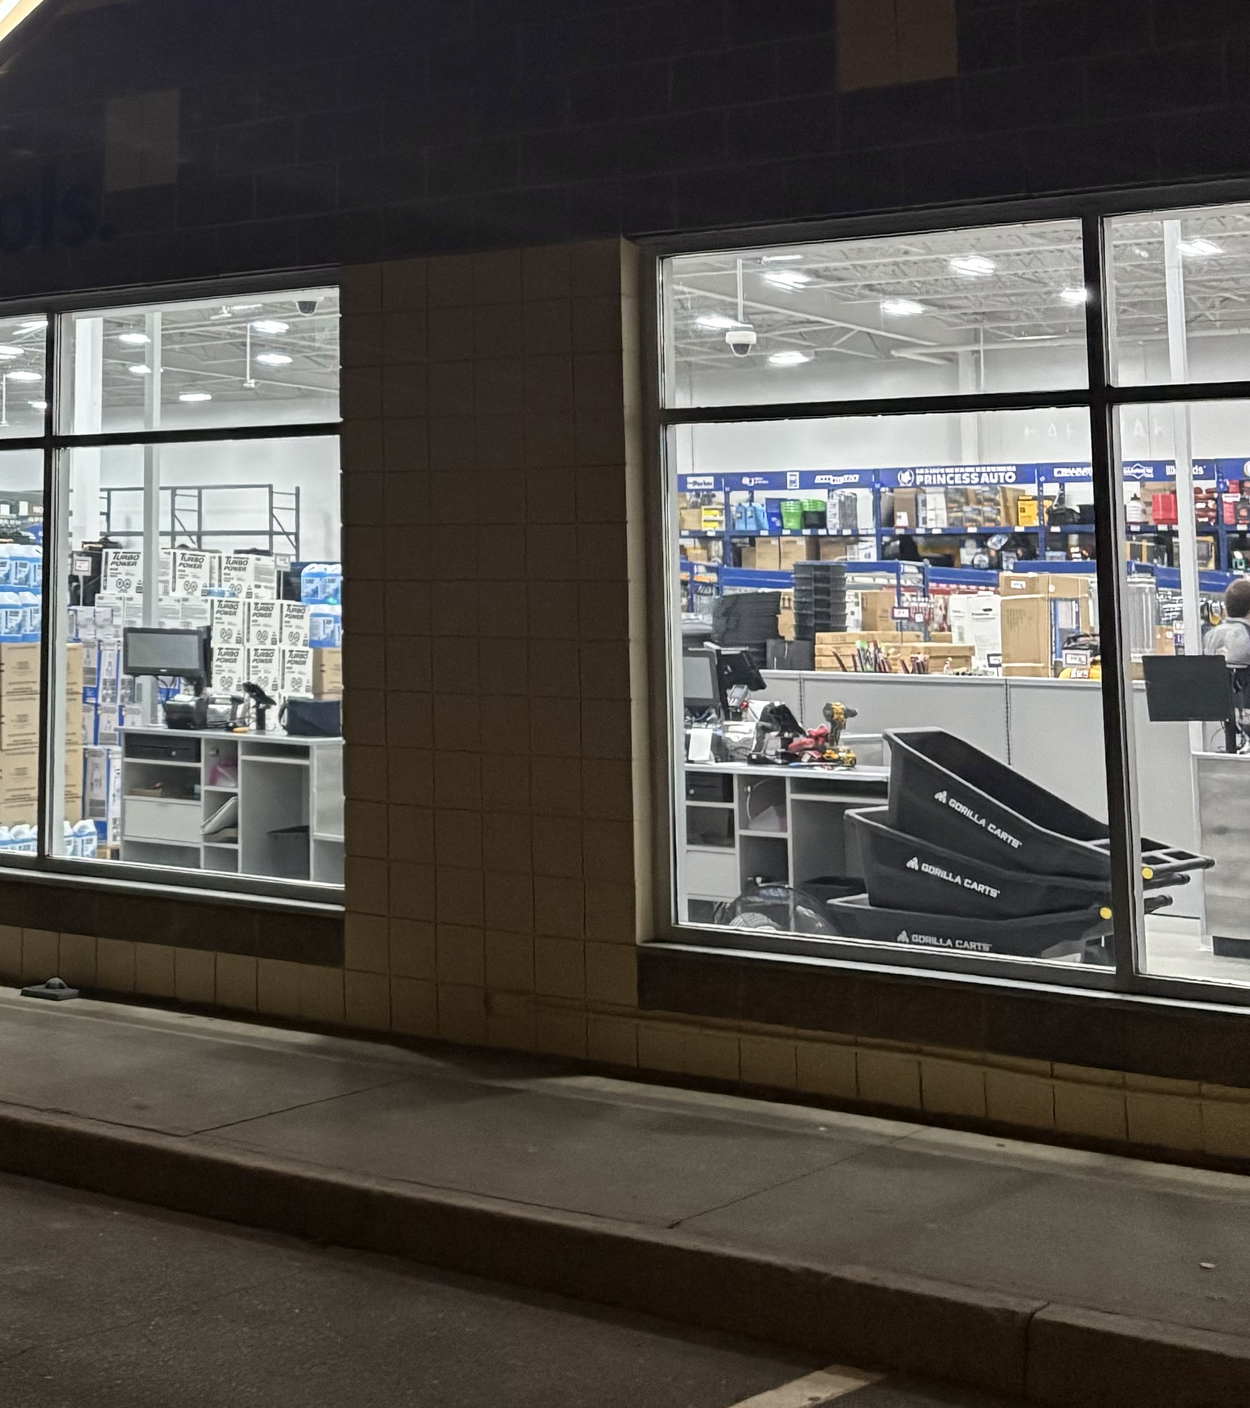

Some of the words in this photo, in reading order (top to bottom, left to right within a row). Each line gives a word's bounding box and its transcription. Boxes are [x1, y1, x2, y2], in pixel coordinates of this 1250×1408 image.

[915, 472, 980, 485] PRINCESS
[980, 471, 1017, 484] AUTO
[112, 551, 142, 561] TURBO
[180, 552, 206, 563] TURBO
[224, 555, 249, 566] TURBO
[948, 798, 986, 828] GORILLA
[987, 823, 1021, 849] CARTS
[920, 862, 962, 885] GORILLA
[963, 878, 999, 898] CARTS
[911, 934, 953, 947] GORILLA
[955, 939, 991, 952] CARTS
